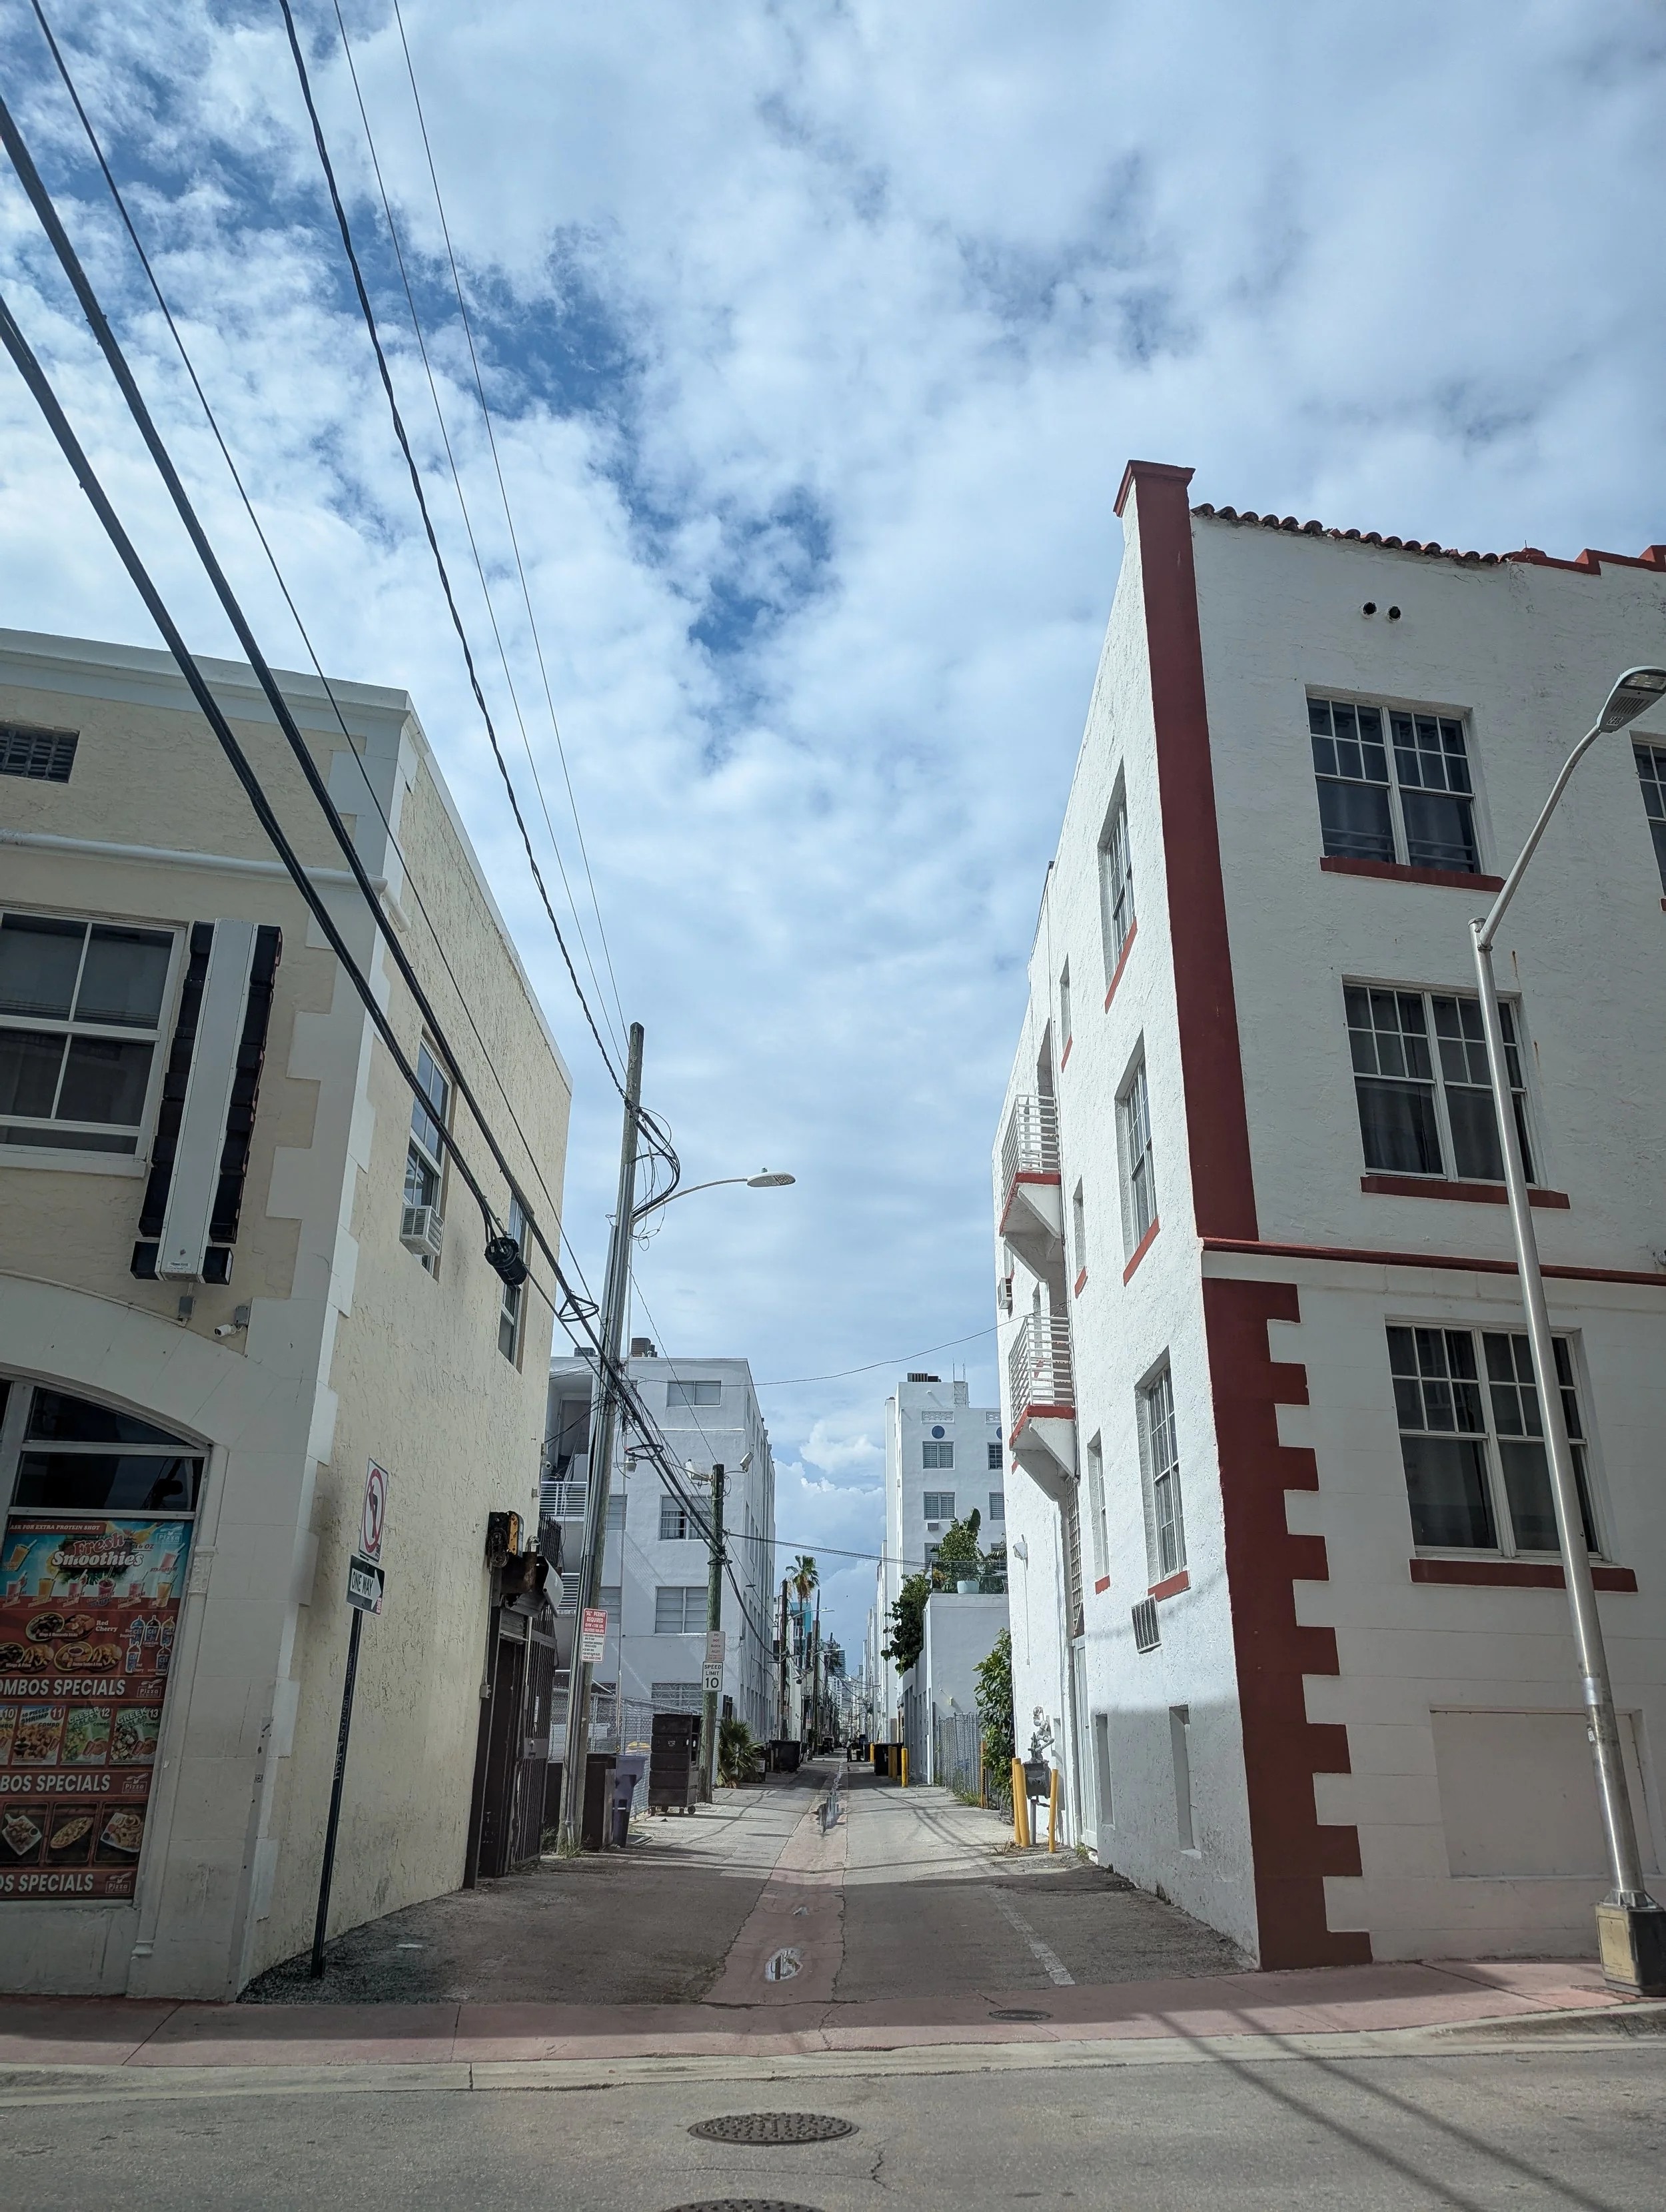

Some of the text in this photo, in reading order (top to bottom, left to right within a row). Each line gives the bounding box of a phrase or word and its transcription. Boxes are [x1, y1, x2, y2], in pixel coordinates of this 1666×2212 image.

[73, 1532, 125, 1557] Fresh
[52, 1551, 144, 1566] Smoothies
[352, 1571, 373, 1597] ONE WAY
[53, 1679, 126, 1696] SPECIALS
[705, 1677, 719, 1688] 10
[4, 1708, 14, 1718] 10
[21, 1712, 49, 1724] SHRIMP
[53, 1708, 63, 1718] 11
[69, 1706, 100, 1724] CAESAR
[101, 1708, 111, 1717] 12
[117, 1706, 147, 1724] GREEK
[150, 1708, 159, 1718] 13
[0, 1775, 111, 1792] BOS SPECIALS
[19, 1874, 94, 1892] SPECIALS
